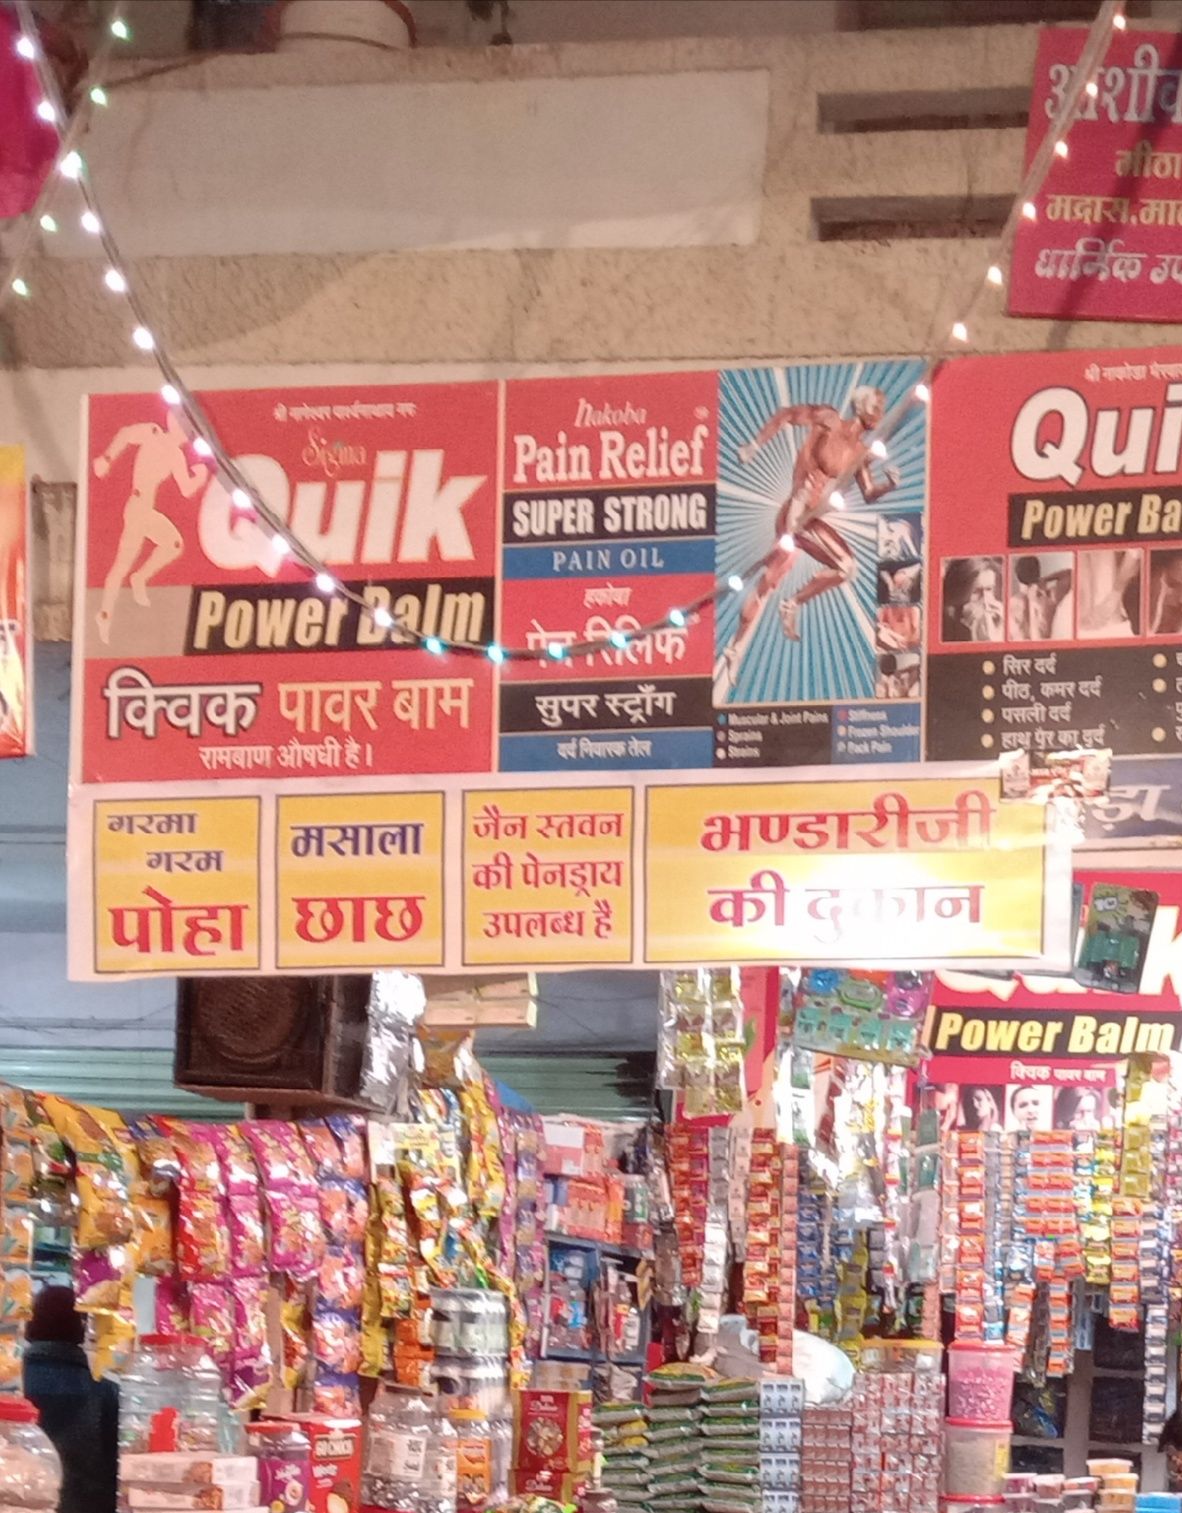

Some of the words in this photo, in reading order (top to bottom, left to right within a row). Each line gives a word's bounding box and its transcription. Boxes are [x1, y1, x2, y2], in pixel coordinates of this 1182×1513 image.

[514, 437, 593, 484] Pain
[599, 424, 709, 479] Relief
[199, 449, 487, 577] Quik
[513, 498, 594, 537] SUPER
[604, 494, 707, 533] STRONG
[1021, 496, 1132, 540] Power
[552, 551, 616, 572] PAIN
[621, 547, 664, 570] OIL
[193, 587, 348, 650] Power
[360, 583, 486, 646] Balm
[1003, 654, 1032, 676] सिर
[1034, 652, 1057, 675] दर्द
[103, 667, 262, 739] क्विक
[278, 681, 382, 733] पावर
[391, 678, 474, 730] बाम
[1040, 681, 1076, 699] कमर
[1078, 675, 1104, 697] दर्द
[535, 695, 600, 728] सुपर
[1001, 702, 1047, 723] पसली
[1048, 701, 1072, 722] दर्द
[199, 745, 272, 769] रामबाण
[107, 813, 197, 836] गरमा
[290, 823, 424, 857] मसाला
[472, 804, 528, 839] जैन
[536, 813, 624, 839] स्तवन
[146, 849, 223, 873] गरम
[472, 851, 513, 890] की
[520, 852, 624, 897] पेनड्राय
[707, 870, 790, 927] की
[108, 886, 249, 956] पोहा
[292, 896, 426, 944] छाछ
[483, 911, 585, 939] उपलब्ध
[592, 899, 612, 939] है
[935, 1015, 1060, 1052] Power
[1067, 1016, 1175, 1053] Balm
